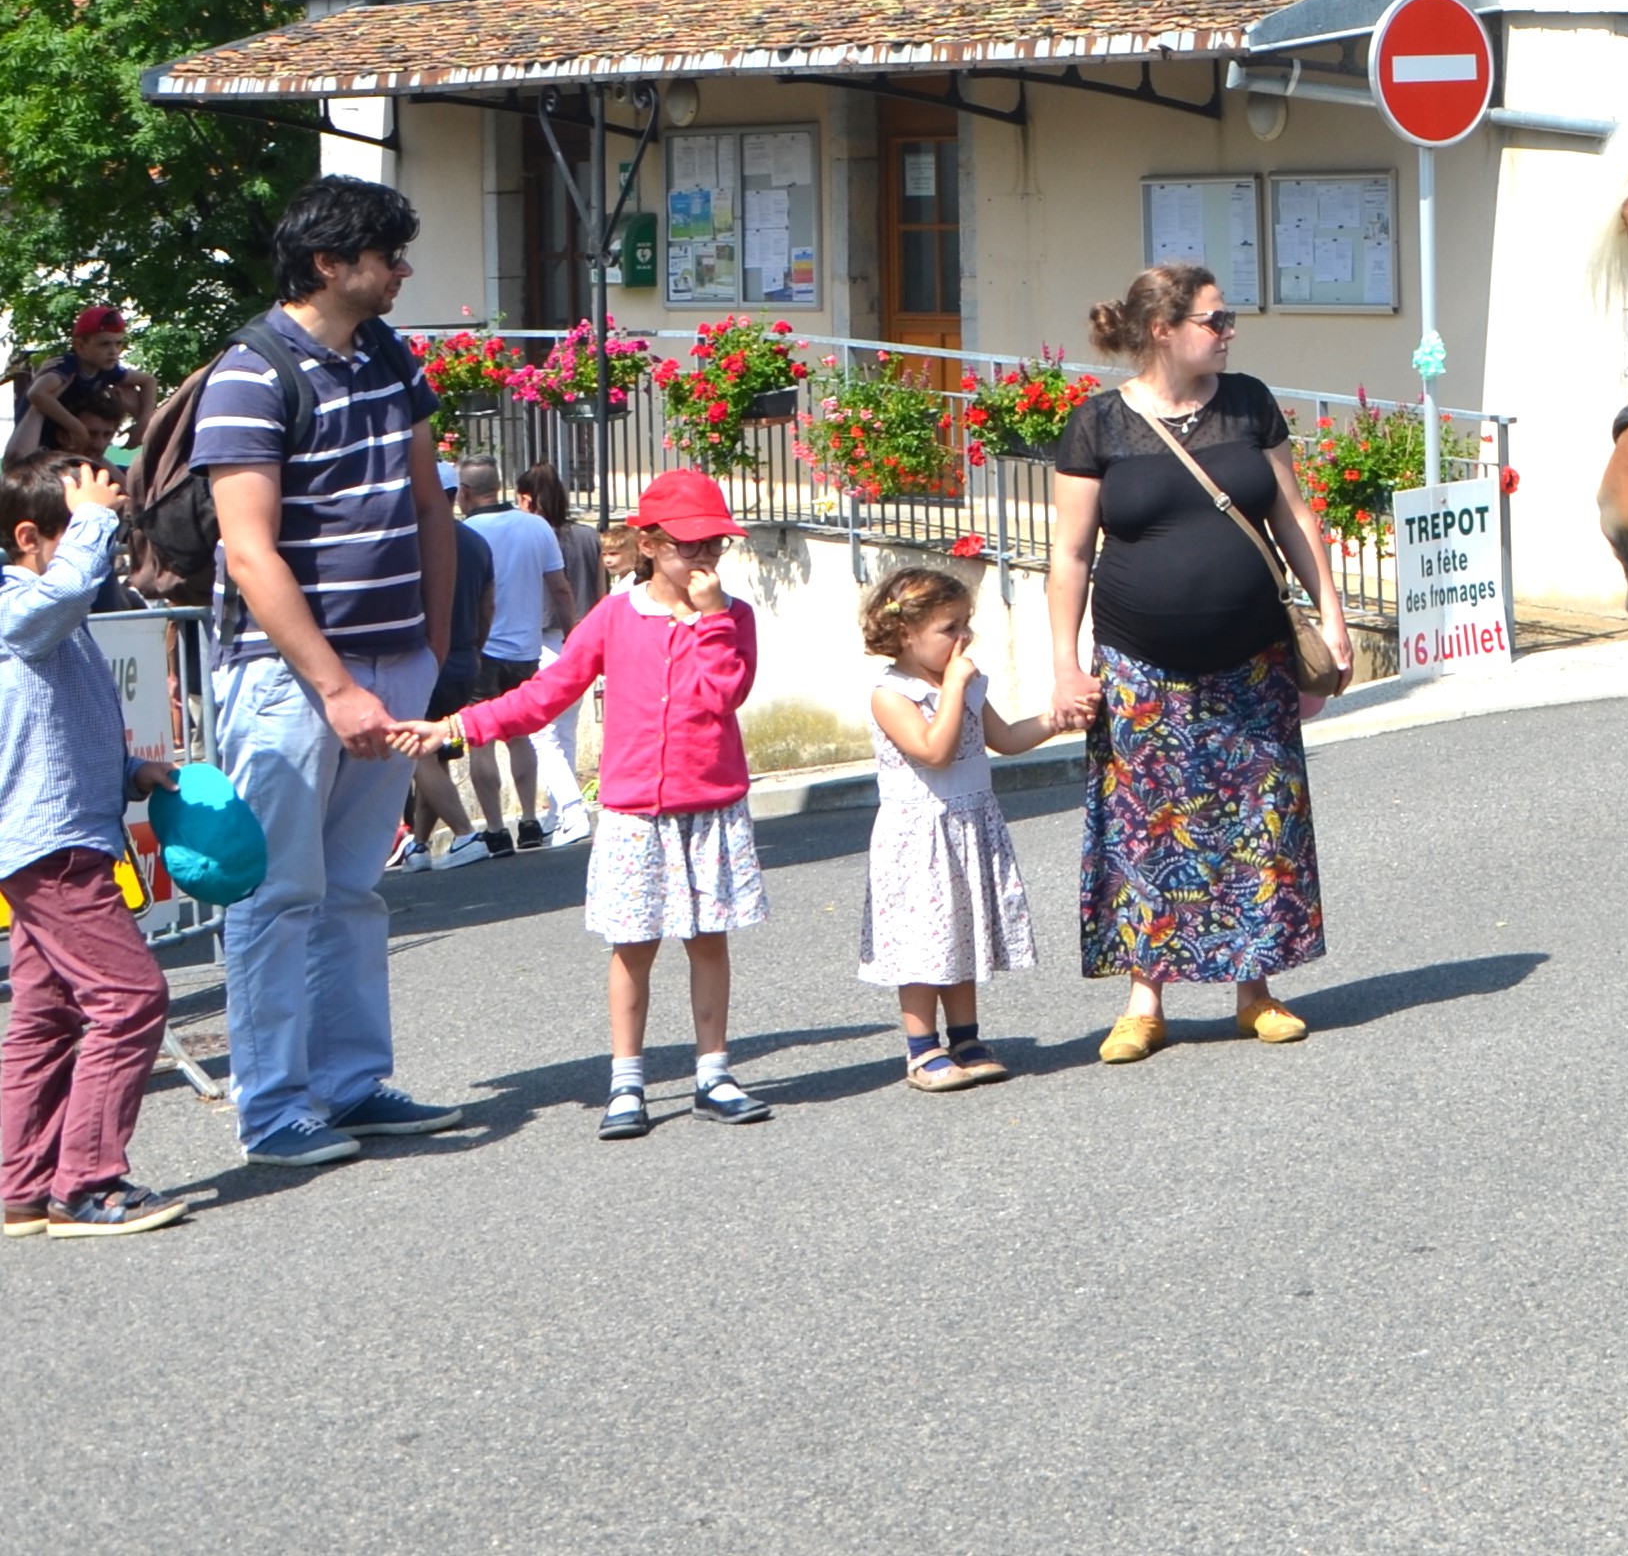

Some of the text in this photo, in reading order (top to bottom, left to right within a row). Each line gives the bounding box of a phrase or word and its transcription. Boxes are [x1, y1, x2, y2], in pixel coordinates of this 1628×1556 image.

[1405, 506, 1489, 545] TREPOT
[1421, 548, 1468, 578] la fête
[1406, 580, 1496, 613] des fromages
[1403, 620, 1506, 668] 16 Juillet
